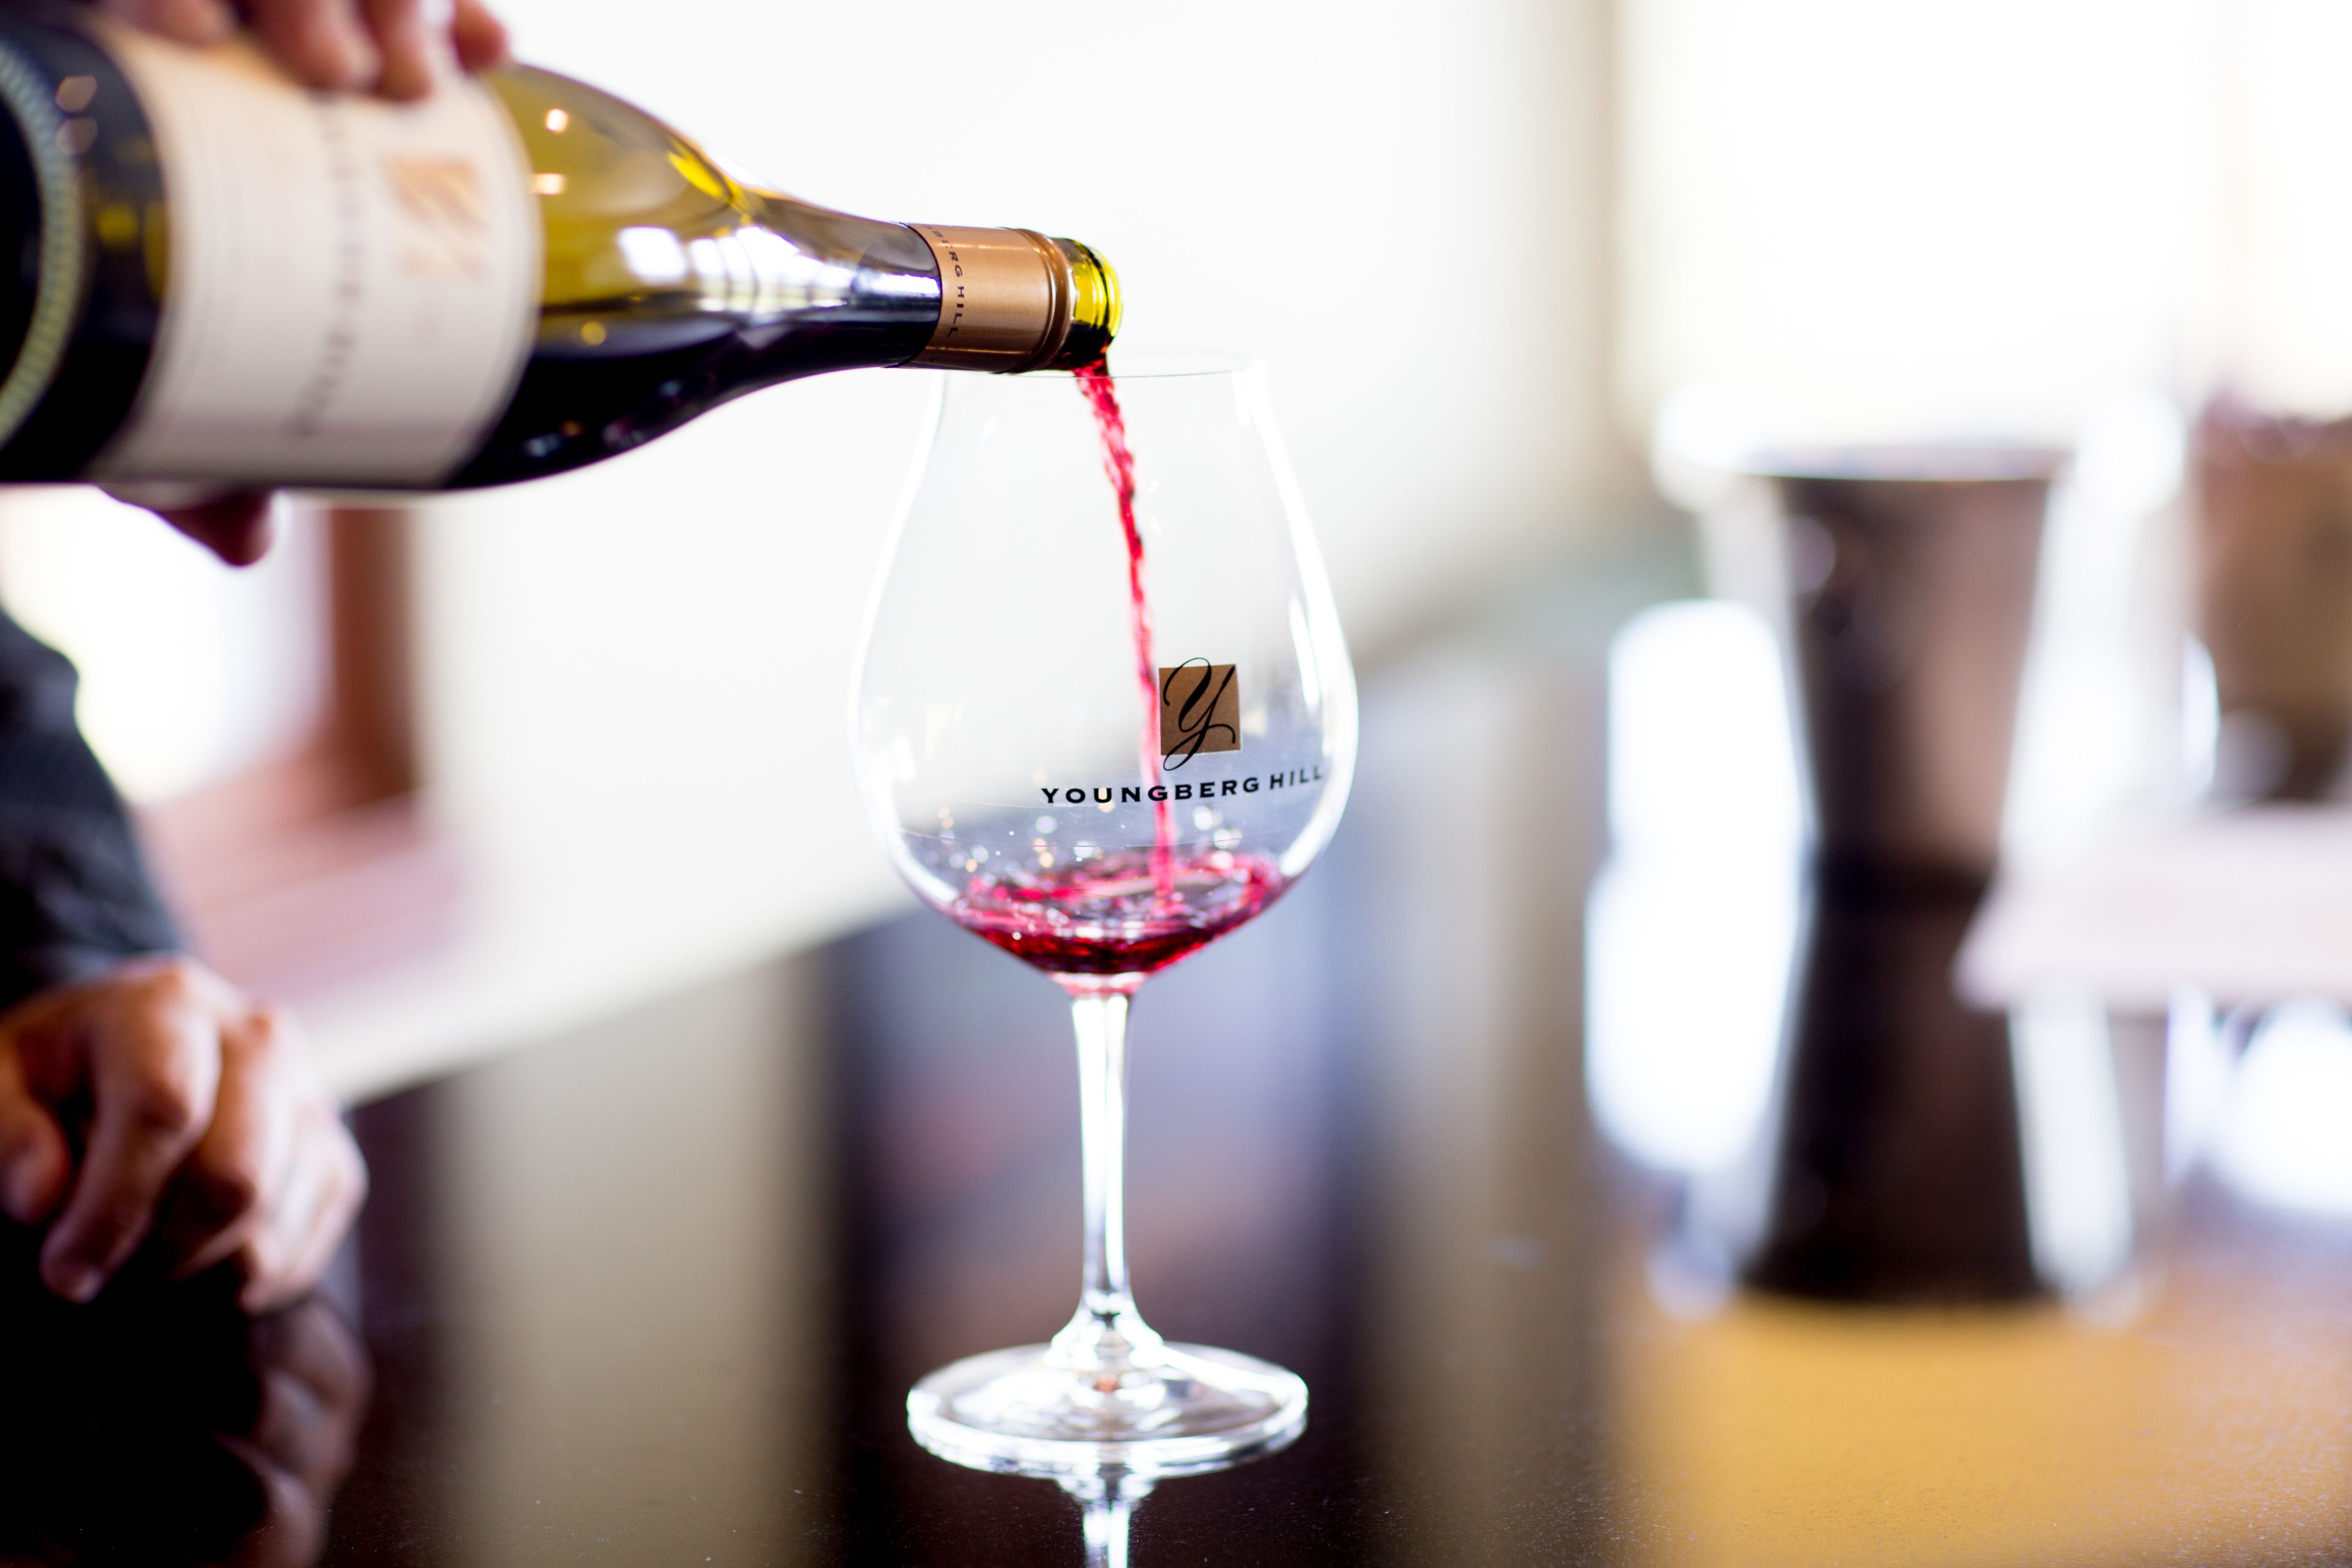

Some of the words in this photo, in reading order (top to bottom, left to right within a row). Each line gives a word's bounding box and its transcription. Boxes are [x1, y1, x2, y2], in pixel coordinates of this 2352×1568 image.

[947, 286, 965, 337] HILL
[1041, 778, 1259, 804] YOUNGBERG
[1270, 765, 1322, 790] HILL
